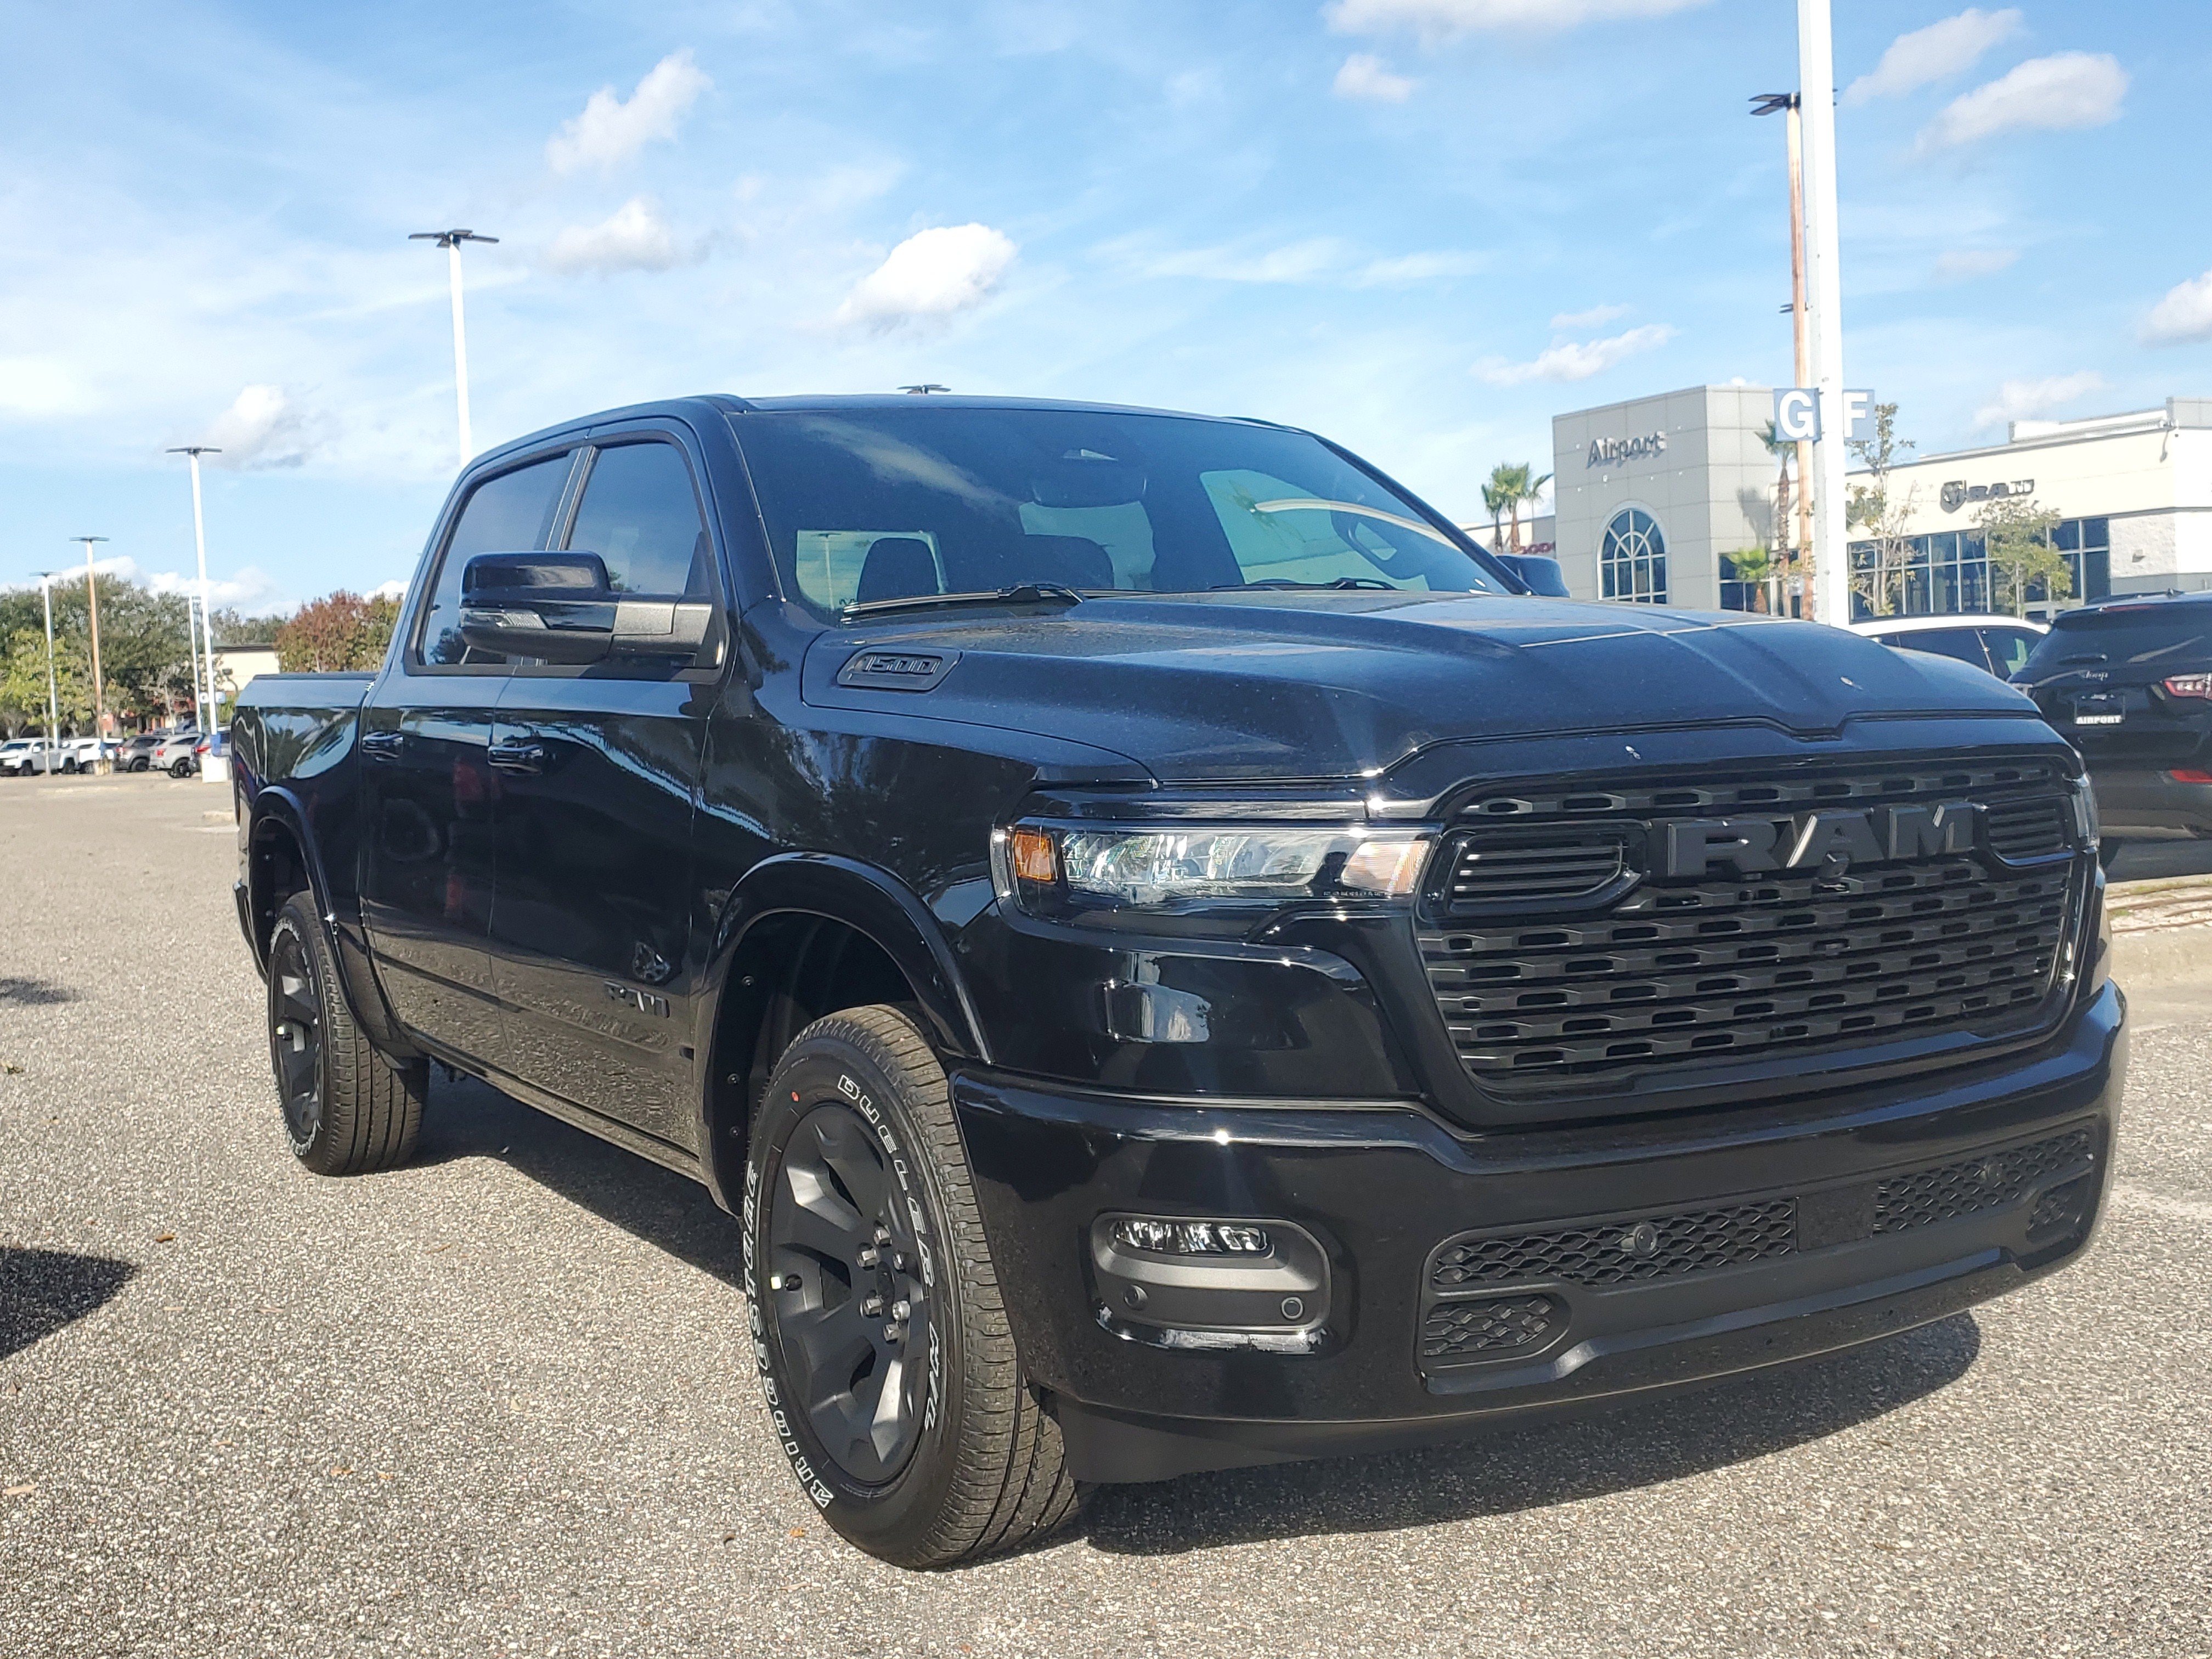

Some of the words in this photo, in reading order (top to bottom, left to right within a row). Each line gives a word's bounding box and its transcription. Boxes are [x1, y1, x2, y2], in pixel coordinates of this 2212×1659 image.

[1779, 391, 1814, 438] G
[1843, 392, 1867, 438] F
[1586, 431, 1666, 469] Airport
[862, 655, 941, 675] 1500
[2076, 715, 2123, 725] AIRPORT
[1667, 802, 1976, 877] RAM
[838, 1074, 935, 1287] DUELER
[743, 1160, 834, 1508] BRIDGESTONE
